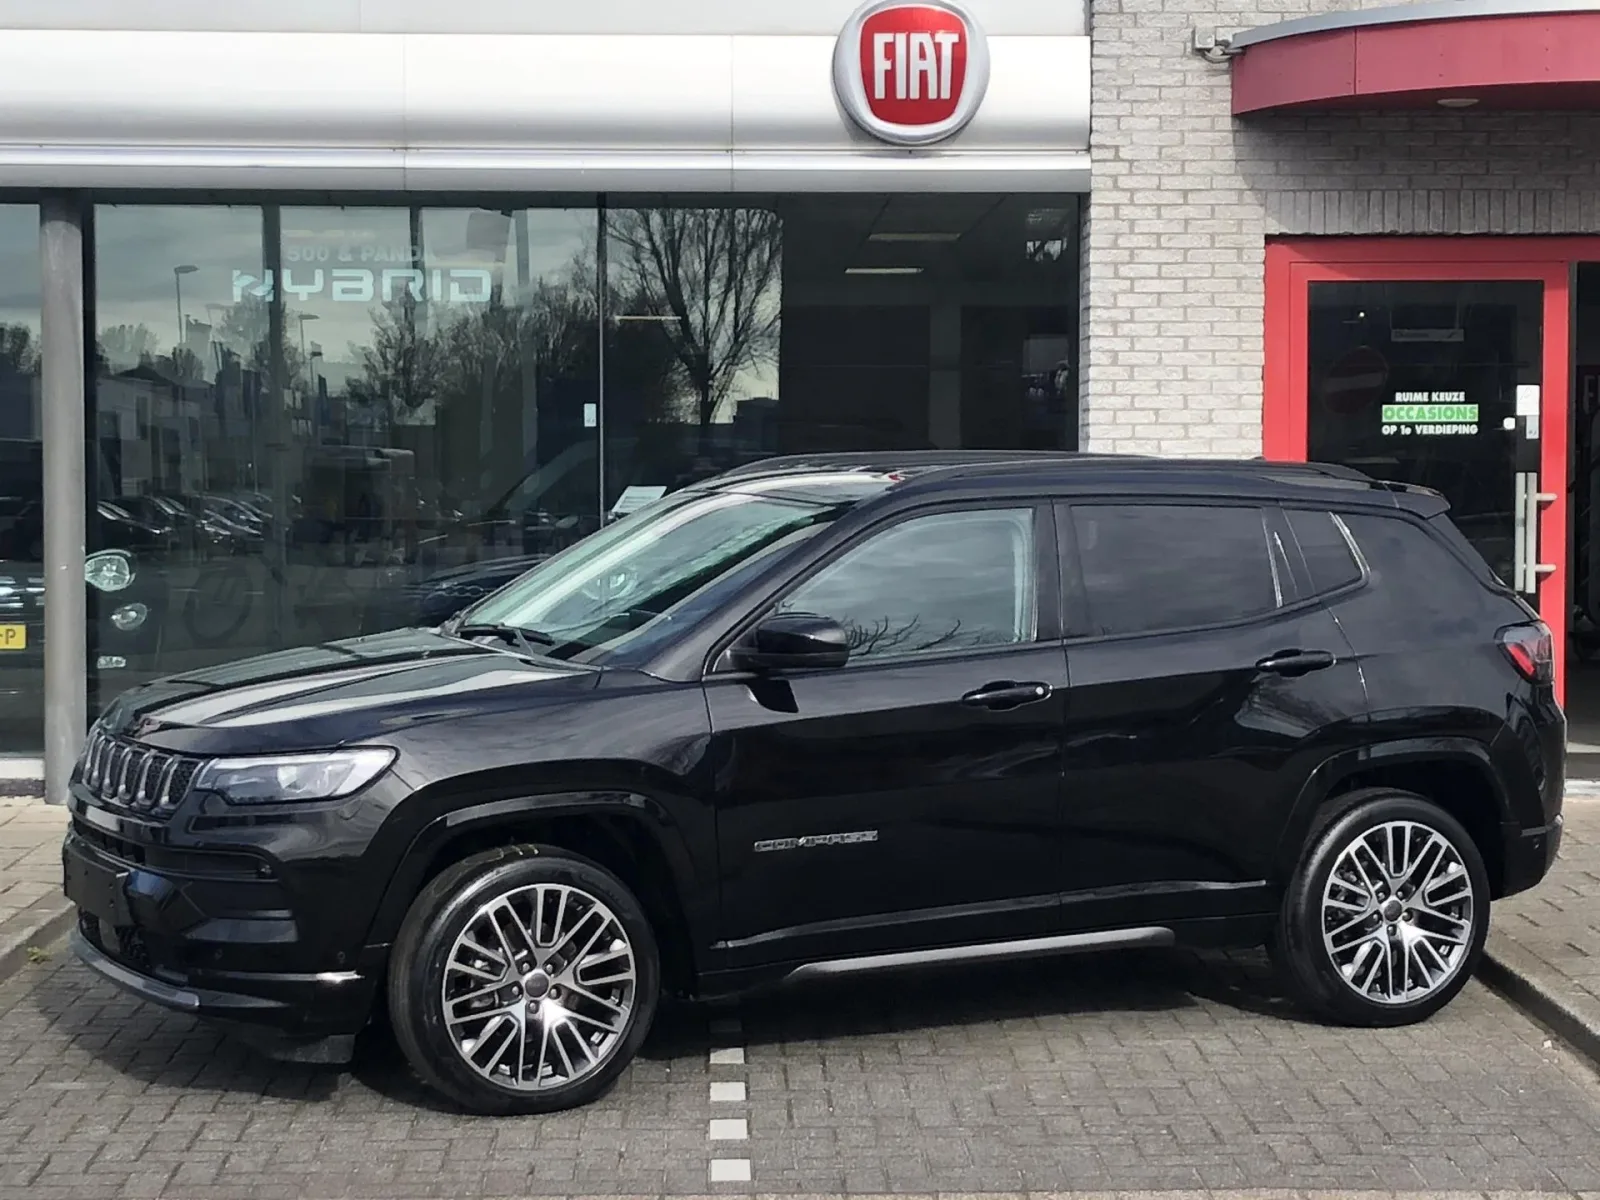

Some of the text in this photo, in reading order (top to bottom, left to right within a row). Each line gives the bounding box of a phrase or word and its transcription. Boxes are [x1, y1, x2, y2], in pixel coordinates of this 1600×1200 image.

[873, 32, 960, 100] FIAT
[287, 246, 330, 262] 500
[337, 246, 355, 262] &
[232, 268, 493, 302] HYBRID
[1395, 391, 1465, 402] RUIME KEUZE
[1383, 406, 1478, 420] OCCASIONS
[1382, 424, 1398, 435] OP
[1415, 424, 1478, 435] VERDIEPING
